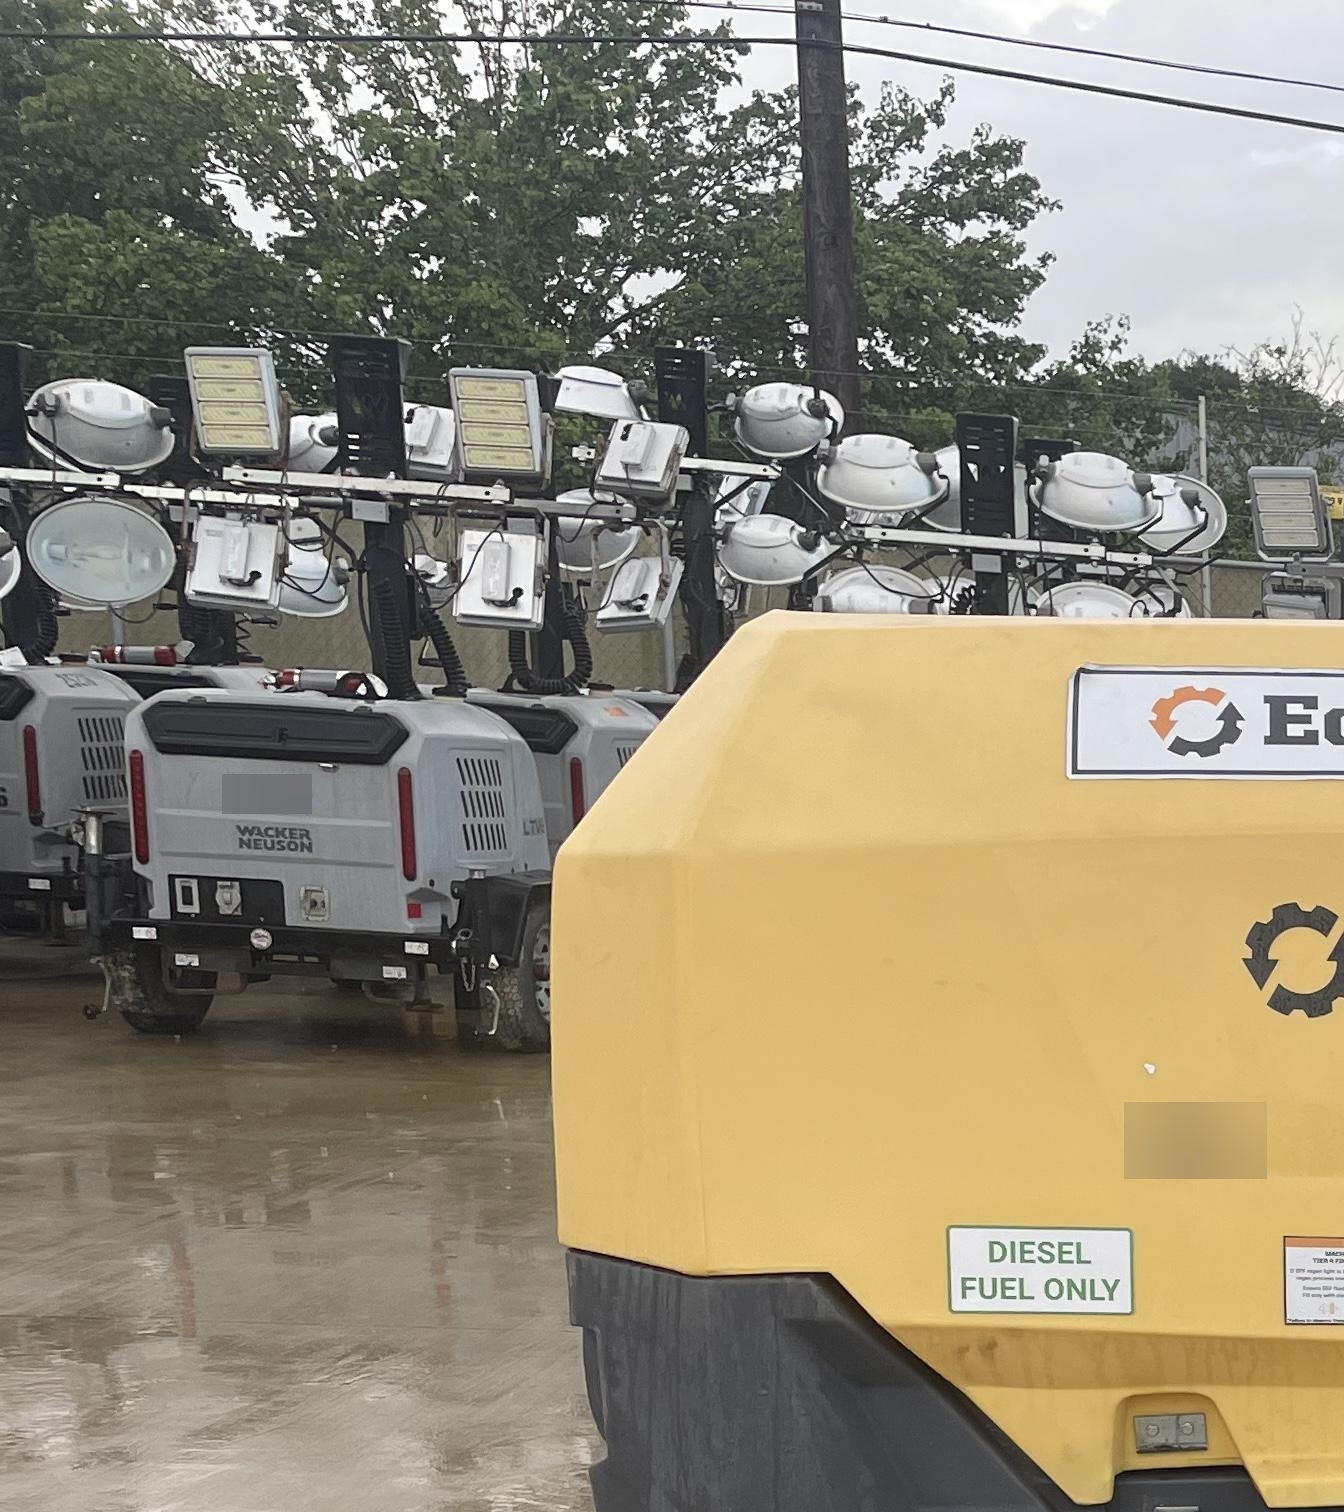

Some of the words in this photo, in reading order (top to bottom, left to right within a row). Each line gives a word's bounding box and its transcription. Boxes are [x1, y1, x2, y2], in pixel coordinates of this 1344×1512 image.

[236, 824, 312, 841] WACKER
[239, 837, 313, 853] NEUSON
[988, 1240, 1092, 1265] DIESEL
[960, 1276, 1035, 1301] FUEL
[1043, 1277, 1121, 1302] ONLY
